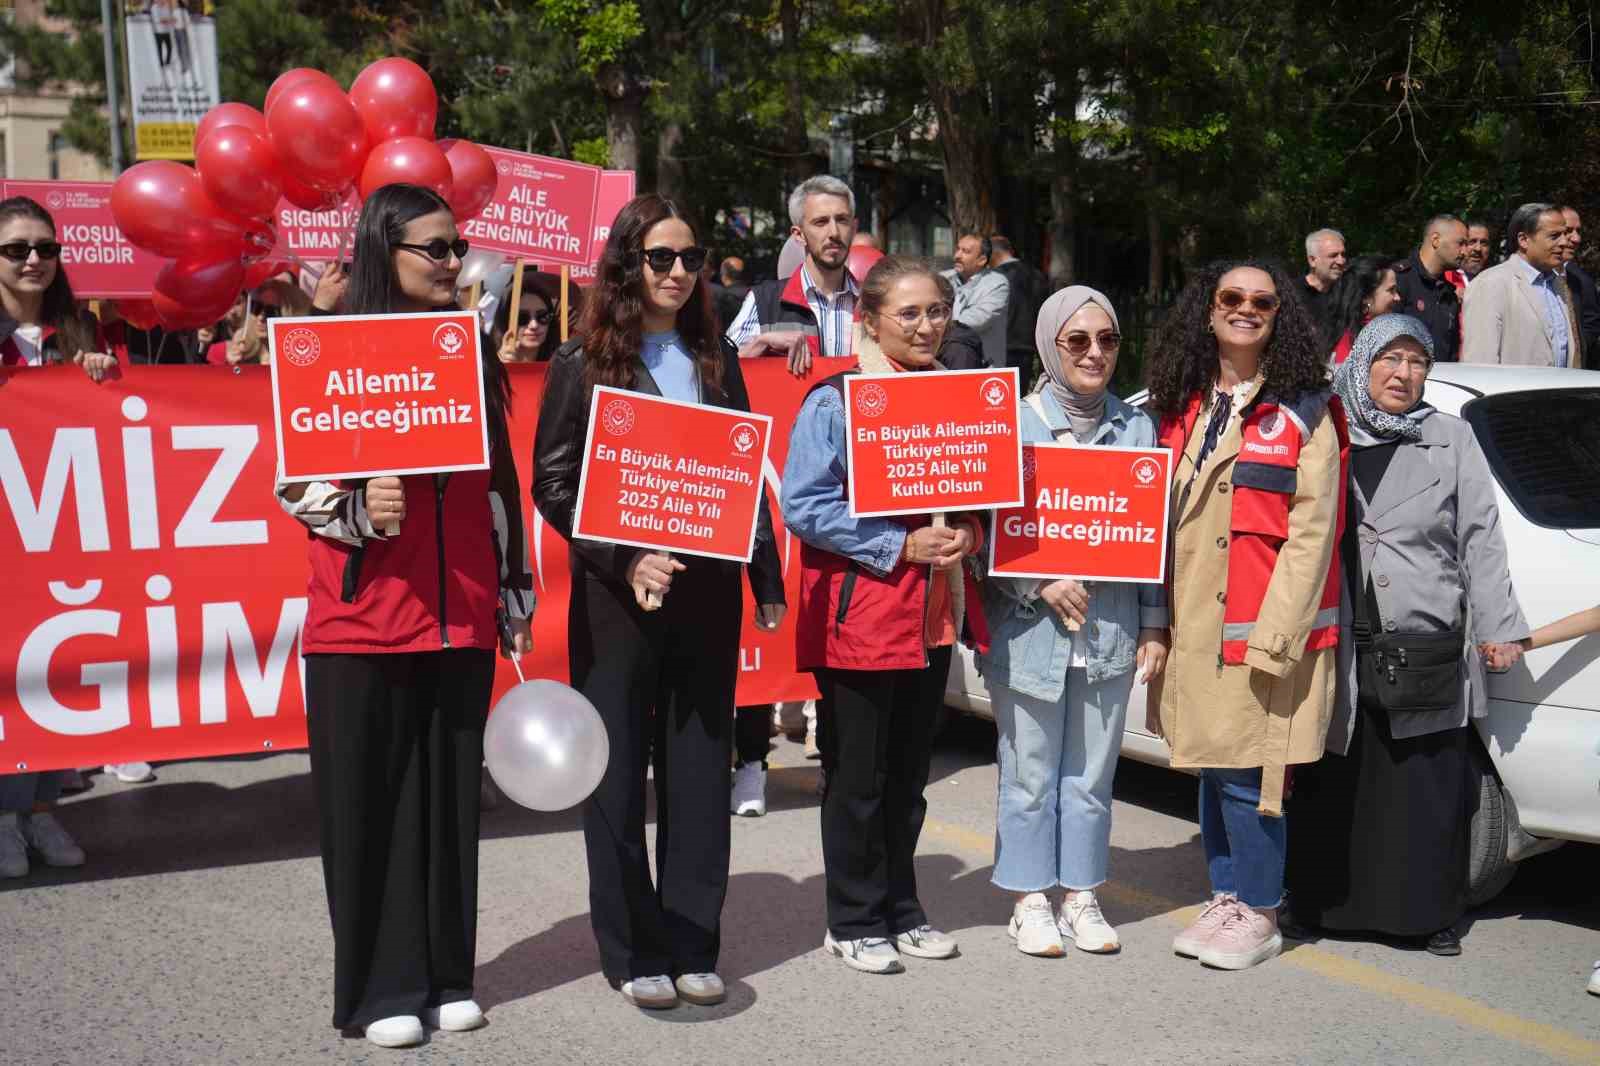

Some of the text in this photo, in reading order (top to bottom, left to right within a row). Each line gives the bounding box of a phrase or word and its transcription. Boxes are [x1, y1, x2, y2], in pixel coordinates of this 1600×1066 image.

[508, 183, 548, 208] AİLE
[510, 205, 569, 232] BÜYÜK
[463, 219, 580, 255] ZENGİNLİKTİR
[324, 366, 436, 396] Ailemiz
[290, 398, 473, 434] Geleceğimiz
[857, 420, 1012, 443] En Büyük Ailemizin,
[595, 443, 753, 485] En Büyük Ailemizin,
[883, 440, 988, 460] Türkiye'mizin
[0, 395, 269, 552] MİZ
[886, 458, 987, 479] 2025 Aile Yılı
[619, 468, 726, 500] Türkiye'mizin
[892, 479, 983, 497] Kutlu Olsun
[618, 490, 721, 519] 2025 Aile Yılı
[1035, 487, 1129, 513] Ailemiz
[620, 511, 713, 539] Kutlu Olsun
[1004, 515, 1156, 546] Geleceğimiz
